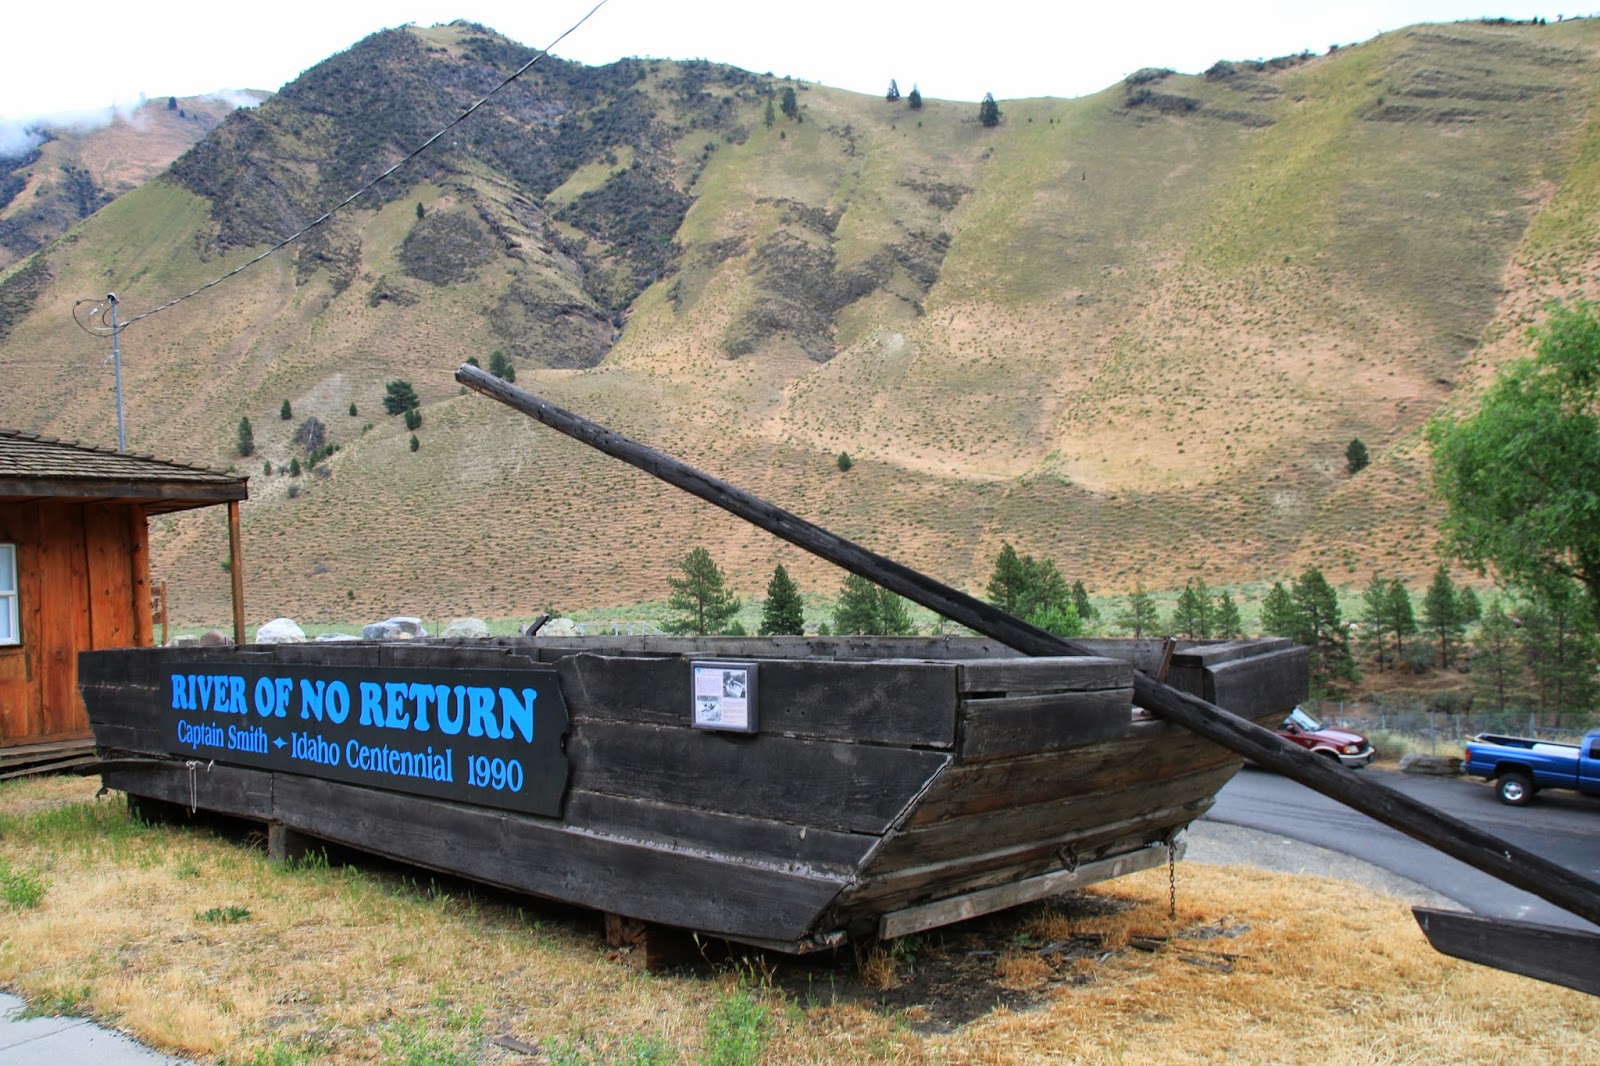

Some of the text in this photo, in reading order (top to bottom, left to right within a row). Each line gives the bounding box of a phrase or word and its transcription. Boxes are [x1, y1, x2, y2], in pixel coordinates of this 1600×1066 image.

[171, 674, 538, 744] RIVER OF NO RETURN
[177, 719, 524, 793] Captain Smith Idaho Centennial 1990
